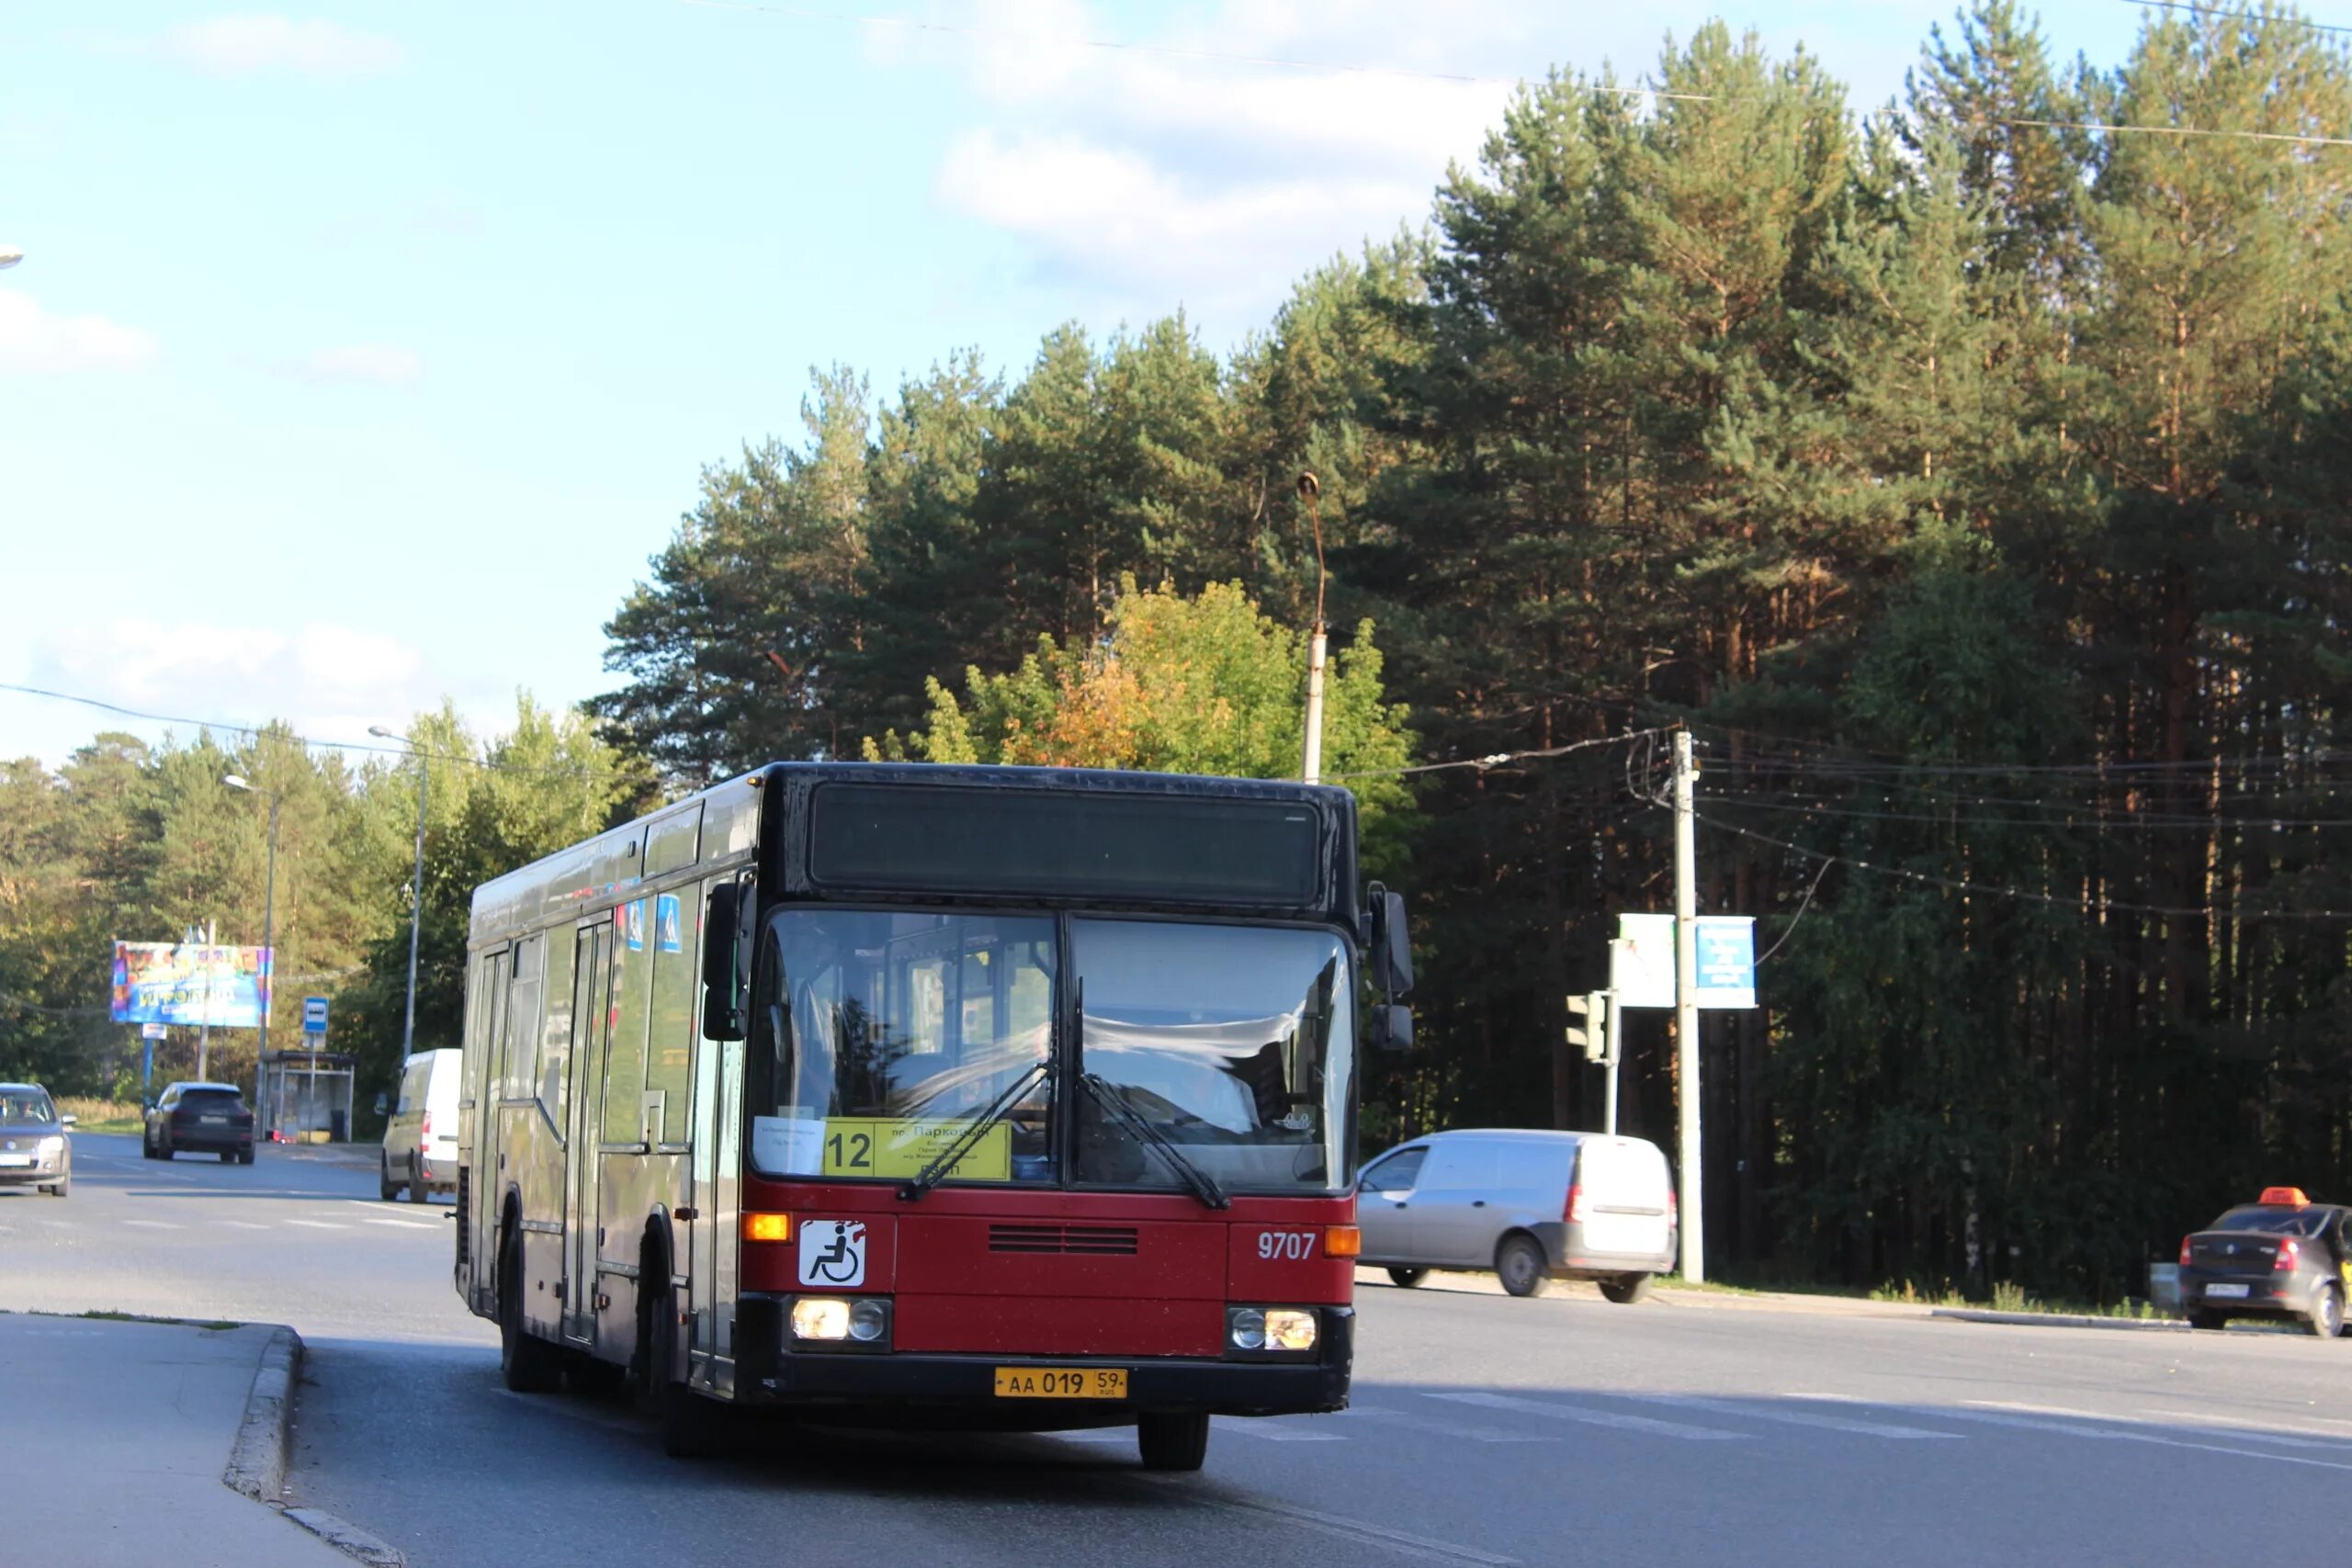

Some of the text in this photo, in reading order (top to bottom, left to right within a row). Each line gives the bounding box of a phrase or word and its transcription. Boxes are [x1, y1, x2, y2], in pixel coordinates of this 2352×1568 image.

[828, 1133, 871, 1168] 12
[1258, 1232, 1316, 1259] 9707
[1043, 1372, 1084, 1393] 019
[1097, 1372, 1118, 1388] 59
